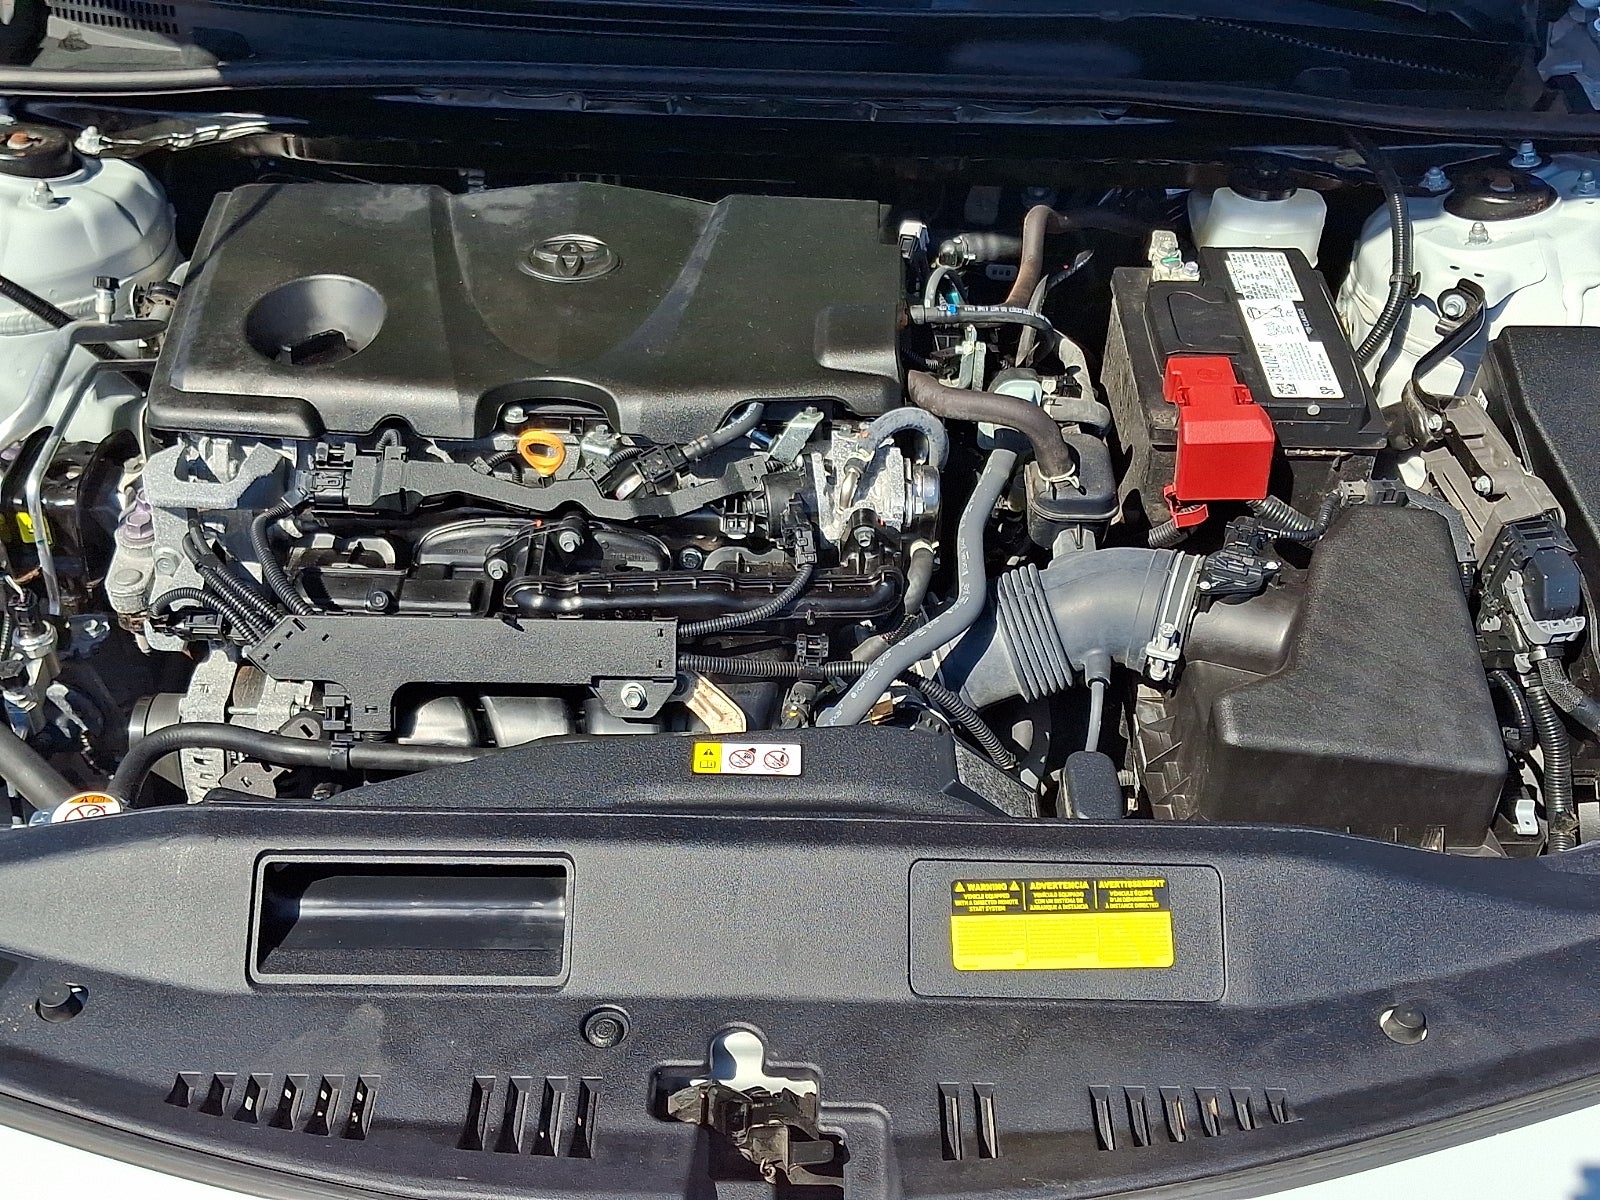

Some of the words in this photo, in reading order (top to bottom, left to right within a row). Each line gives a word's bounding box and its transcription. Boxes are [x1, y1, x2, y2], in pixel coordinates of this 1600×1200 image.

[1319, 386, 1336, 395] SP
[966, 882, 1008, 892] WARNING
[1030, 881, 1090, 890] ADVERTENCIA
[1098, 879, 1166, 889] AVERTISSEMENT
